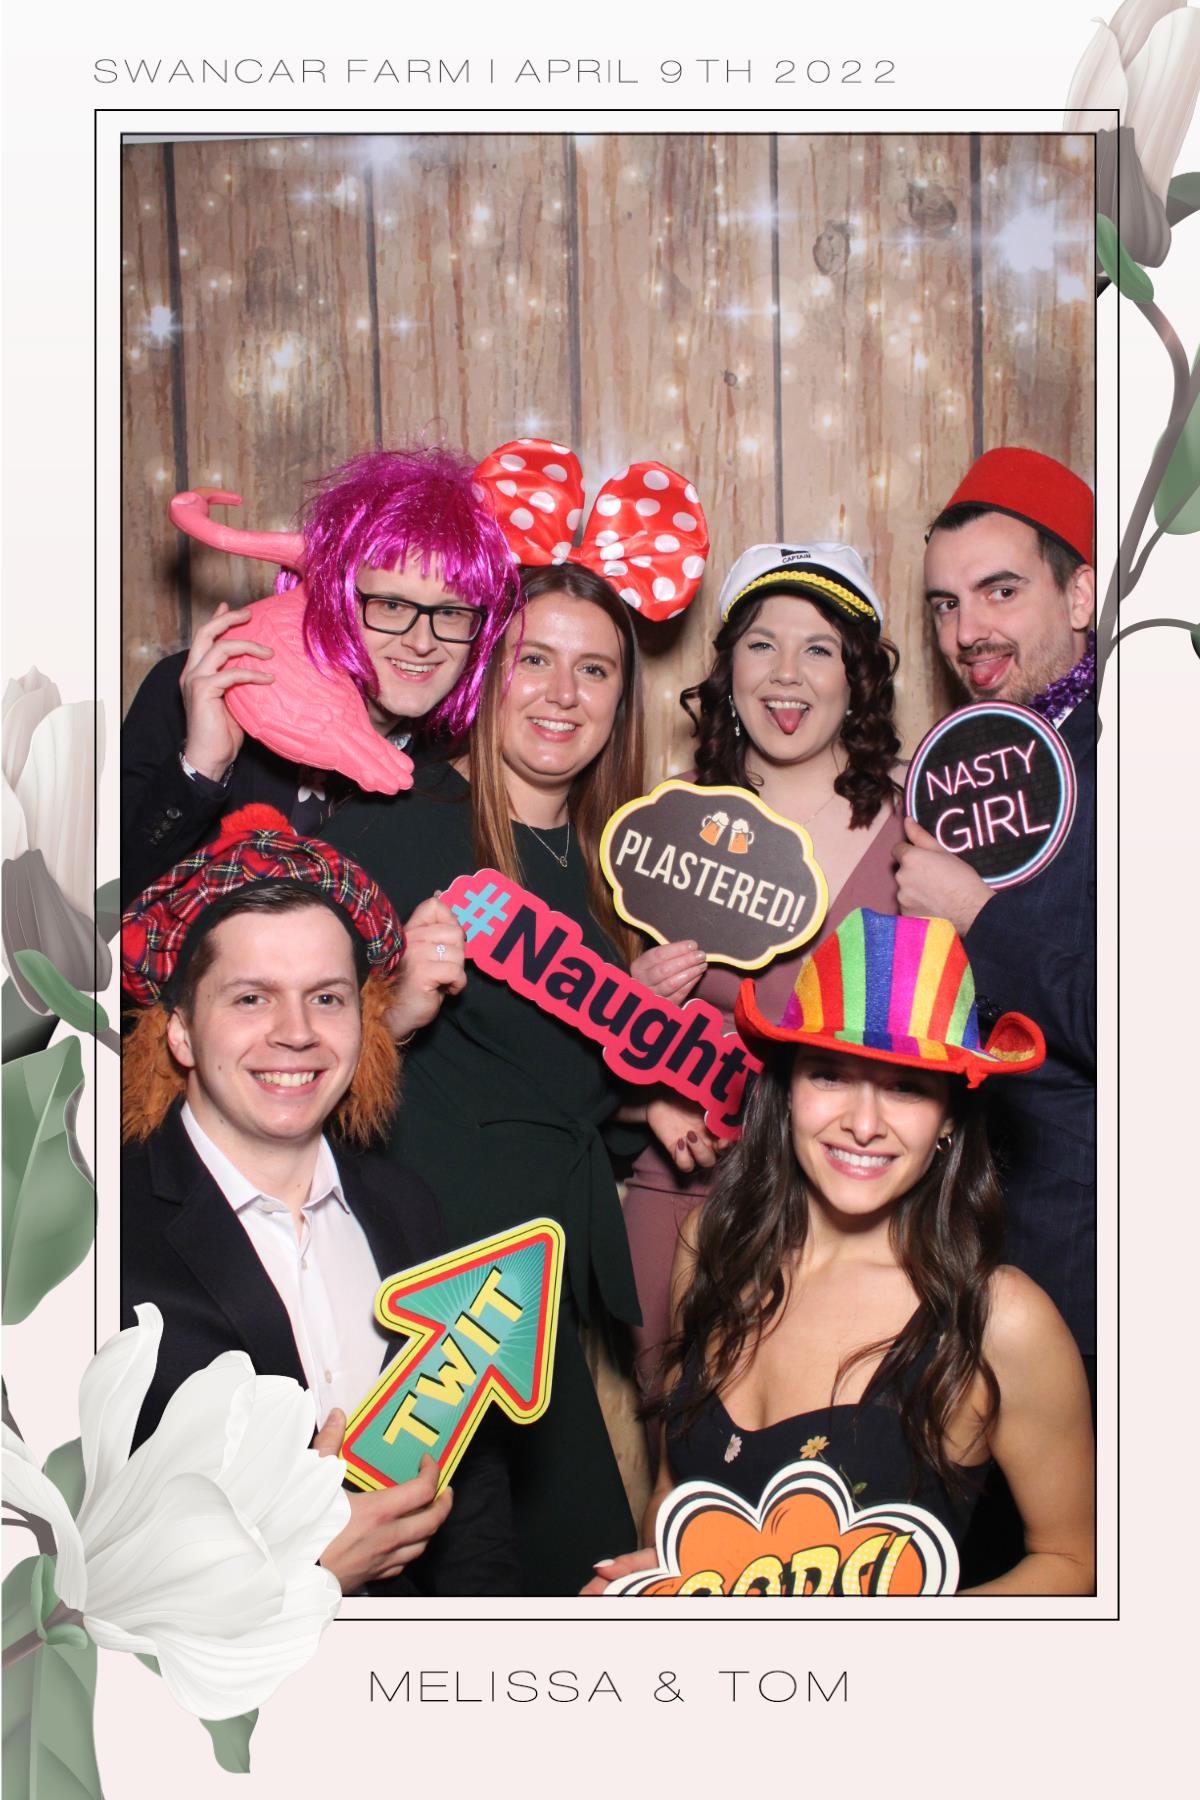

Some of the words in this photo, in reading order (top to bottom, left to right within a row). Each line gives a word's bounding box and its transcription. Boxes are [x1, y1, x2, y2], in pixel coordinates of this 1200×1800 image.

[782, 553, 812, 564] CAPTAIN
[925, 739, 1037, 802] NASTY
[935, 789, 1051, 854] GIRL
[614, 828, 808, 934] PLASTERED!
[382, 1265, 525, 1448] TWIT
